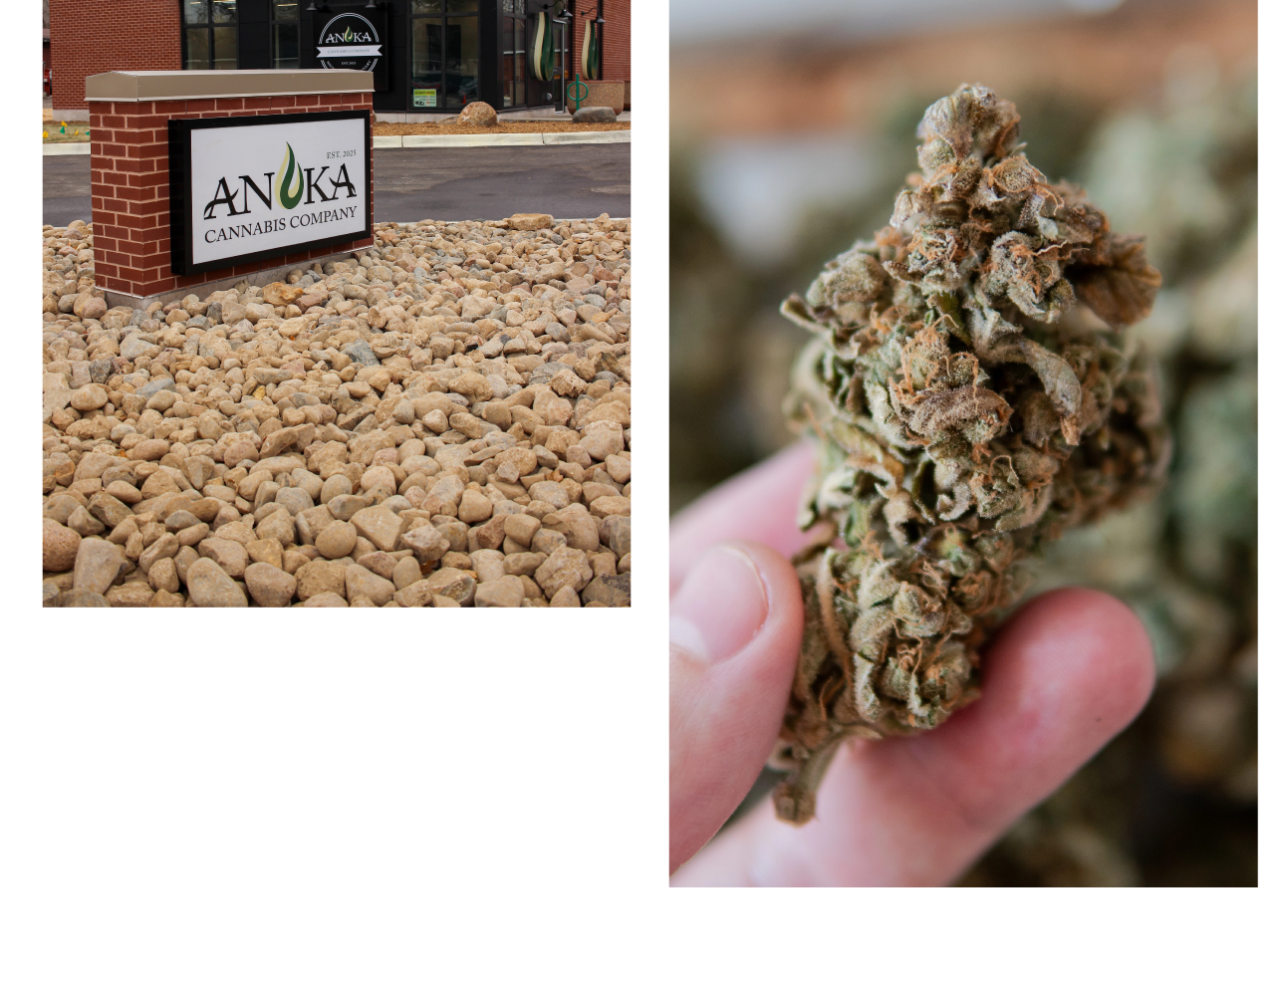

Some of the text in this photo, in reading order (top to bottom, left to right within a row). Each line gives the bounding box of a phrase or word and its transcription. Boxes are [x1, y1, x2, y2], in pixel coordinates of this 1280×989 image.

[326, 149, 357, 160] EST. 2025
[204, 206, 358, 244] CANNABIS COMPANY
